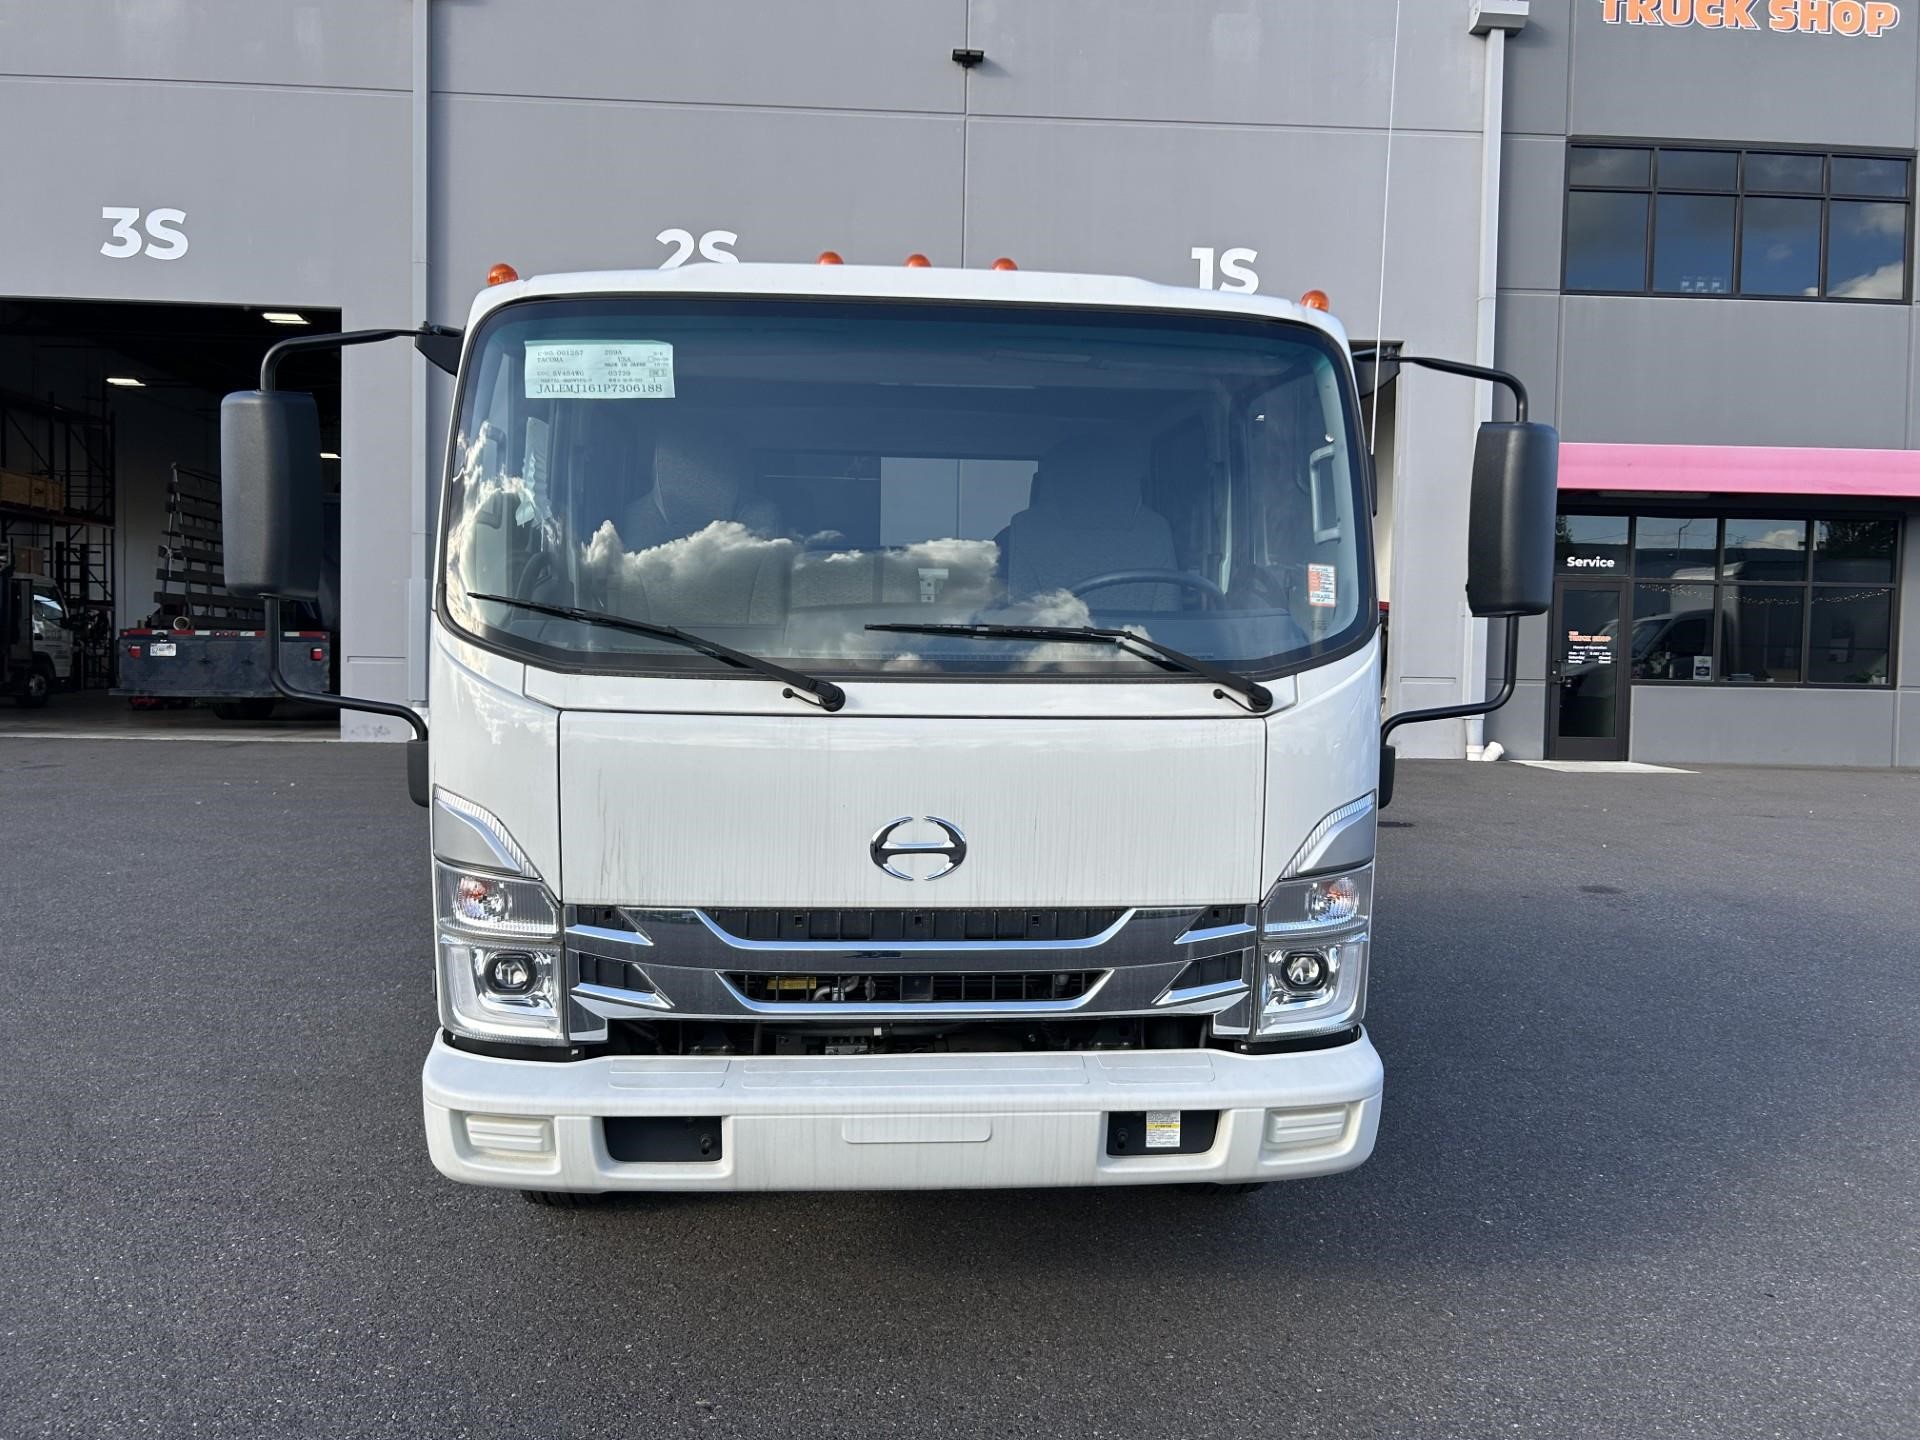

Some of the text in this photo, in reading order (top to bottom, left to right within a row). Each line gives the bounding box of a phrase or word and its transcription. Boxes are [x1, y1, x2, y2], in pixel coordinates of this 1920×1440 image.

[1603, 0, 1900, 37] TRUCK SHOP
[100, 206, 188, 260] 3S
[656, 229, 740, 270] 2S
[1191, 246, 1259, 296] 1S
[536, 383, 663, 394] JALEMJ161P7306188
[1566, 555, 1615, 568] Service
